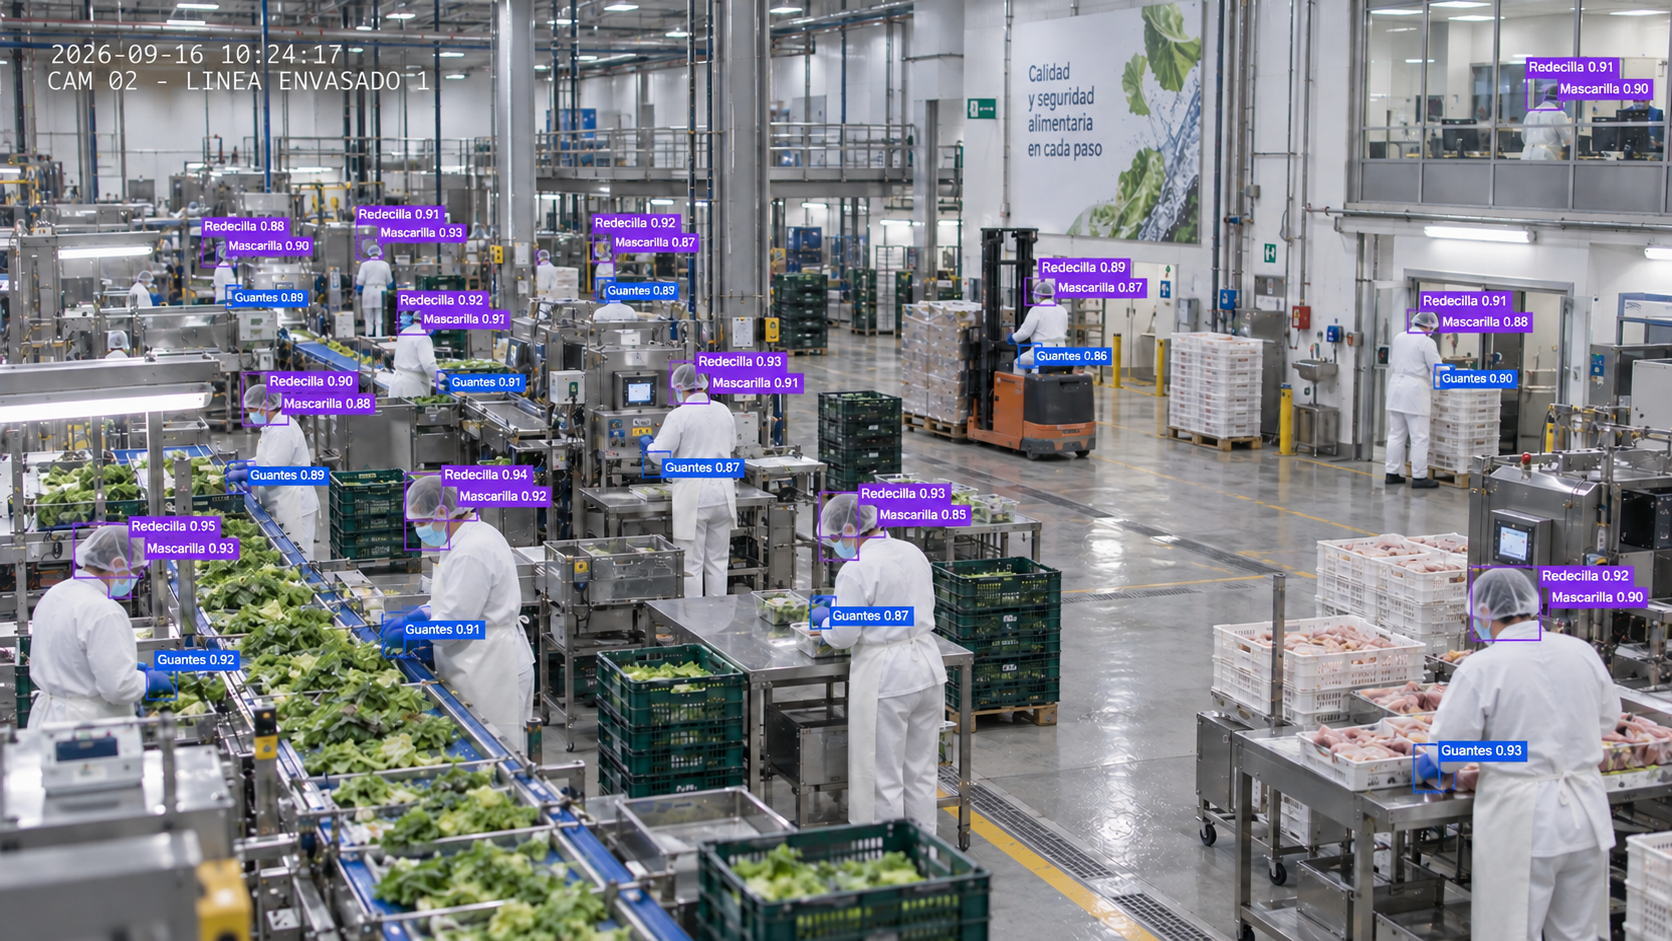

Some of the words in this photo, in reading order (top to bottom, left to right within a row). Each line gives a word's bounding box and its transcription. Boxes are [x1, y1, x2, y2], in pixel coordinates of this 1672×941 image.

[1028, 61, 1070, 82] Calidad
[1028, 94, 1035, 112] y
[1037, 85, 1094, 111] seguridad
[1028, 112, 1093, 132] alimentaria
[1028, 143, 1041, 157] en
[1043, 138, 1070, 157] cada
[1073, 143, 1103, 161] paso
